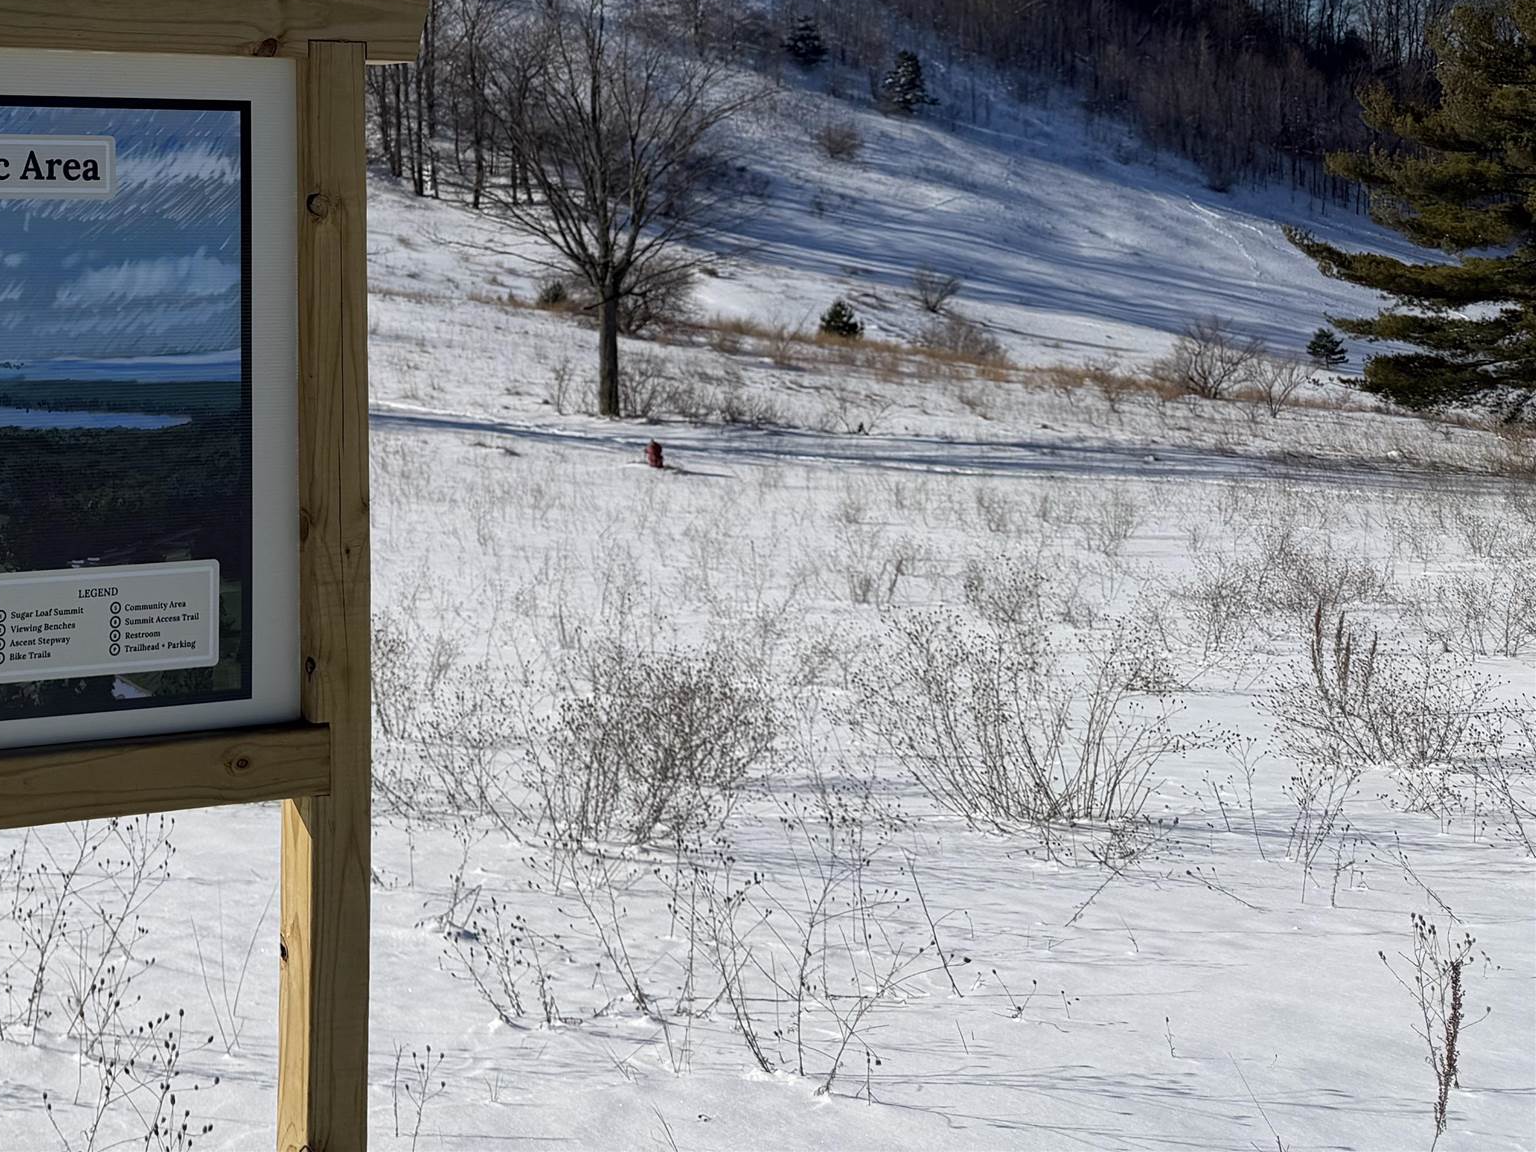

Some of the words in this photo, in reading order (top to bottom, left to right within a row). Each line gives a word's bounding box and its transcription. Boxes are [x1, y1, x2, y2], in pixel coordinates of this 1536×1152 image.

[19, 150, 101, 181] Area
[78, 587, 119, 599] LEGEND
[124, 601, 167, 612] Community
[168, 600, 186, 609] Area
[10, 611, 33, 620] Sugar
[35, 608, 52, 617] Loaf
[54, 607, 84, 616] Summit
[124, 616, 154, 626] Summit
[155, 614, 180, 623] Access
[182, 612, 199, 621] Trail
[10, 624, 42, 633] Viewing
[44, 622, 76, 631] Benches
[124, 631, 161, 639] Restroom
[9, 638, 36, 647] Ascent
[38, 636, 71, 646] Stepway
[124, 642, 160, 652] Trailhead
[167, 640, 196, 650] Parking
[9, 652, 26, 661] Bike
[28, 650, 51, 659] Trails
